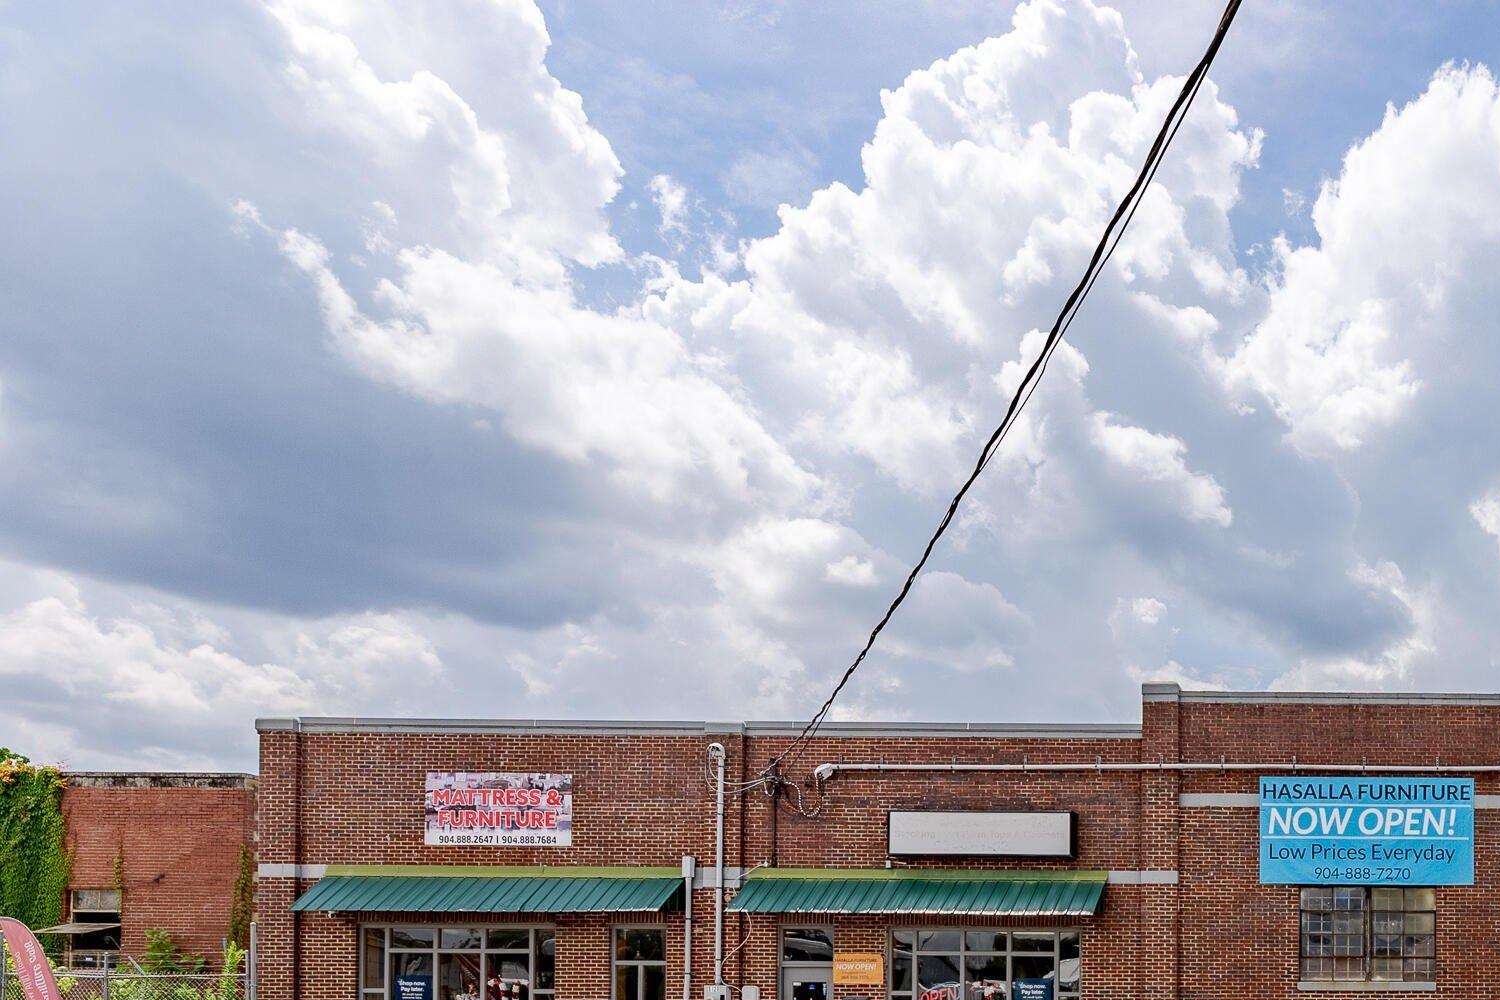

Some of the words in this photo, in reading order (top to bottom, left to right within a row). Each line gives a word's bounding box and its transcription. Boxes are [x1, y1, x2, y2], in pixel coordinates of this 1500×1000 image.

[433, 789, 541, 806] MATTRESS
[546, 789, 562, 806] &
[1263, 784, 1353, 800] HASALLA
[1358, 784, 1470, 800] FURNITURE
[438, 810, 557, 828] FURNITURE
[1268, 808, 1353, 835] NOW
[1358, 808, 1456, 836] OPEN!
[439, 836, 493, 844] 904.888.2647
[502, 836, 556, 844] 904.888.7684
[1270, 844, 1306, 860] Low
[1312, 844, 1366, 860] Prices
[1372, 844, 1455, 863] Everyday
[1314, 868, 1410, 880] 904-888-7270
